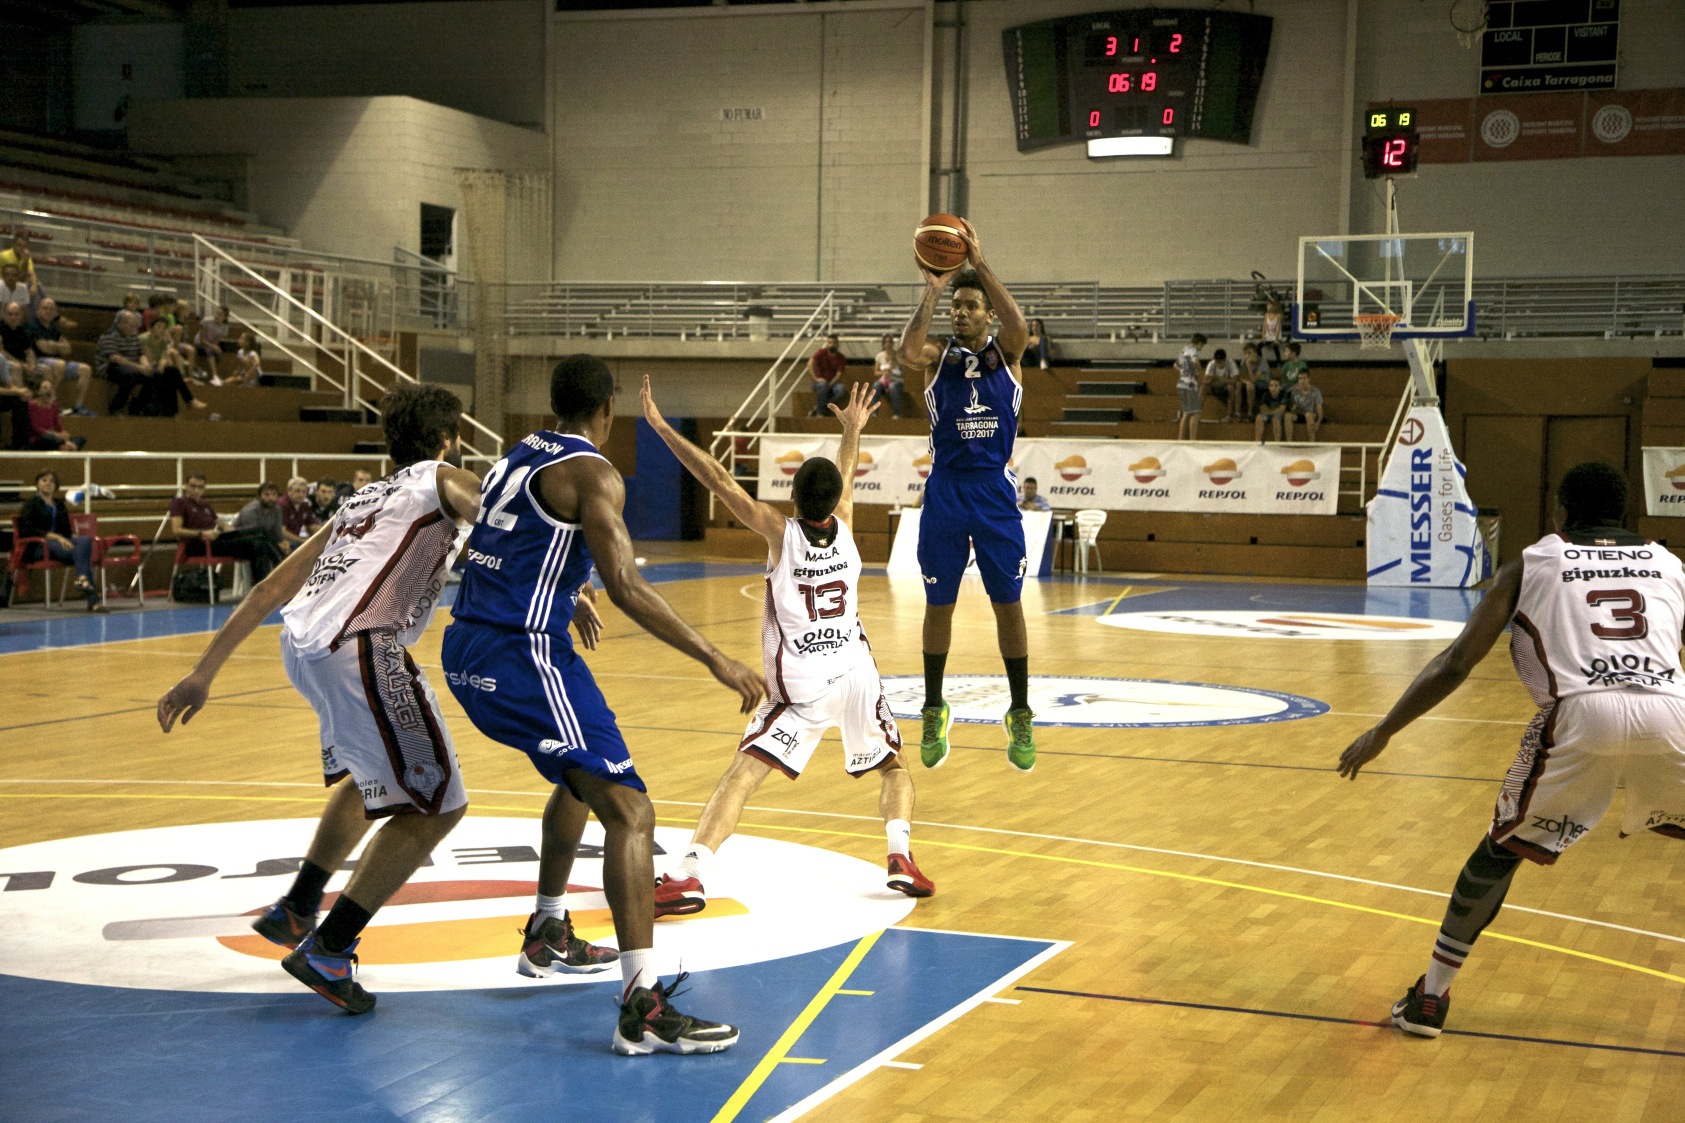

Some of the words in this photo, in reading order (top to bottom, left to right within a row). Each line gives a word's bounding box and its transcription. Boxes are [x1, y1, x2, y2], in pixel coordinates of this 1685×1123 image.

[1494, 32, 1523, 43] LOCAL
[1574, 26, 1609, 38] VISITANT
[1105, 37, 1117, 55] 3
[1170, 34, 1182, 52] 2
[1502, 76, 1541, 88] Caixa
[1544, 74, 1614, 86] Tarragona
[1371, 114, 1387, 127] 06
[1399, 113, 1410, 126] 19
[1384, 139, 1406, 165] 12
[928, 235, 961, 250] molten
[965, 355, 981, 378] 2
[956, 421, 999, 431] TARRAGONA
[976, 429, 995, 438] 2017
[1438, 447, 1453, 472] Life
[771, 479, 793, 489] REP
[854, 481, 882, 491] PSOL
[1050, 486, 1096, 496] REPSOL
[1438, 476, 1453, 496] for
[1123, 487, 1170, 498] REPSOL
[1198, 489, 1247, 500] REPSOL
[1275, 491, 1325, 501] REPSOL
[1659, 494, 1685, 504] REP
[1410, 447, 1433, 583] MESSER
[1437, 501, 1453, 542] Gases
[1563, 549, 1654, 561] OTIENO
[1562, 566, 1663, 583] gipuzkoa
[798, 579, 849, 622] 13
[1586, 589, 1649, 641] 3
[1531, 814, 1590, 842] zaher
